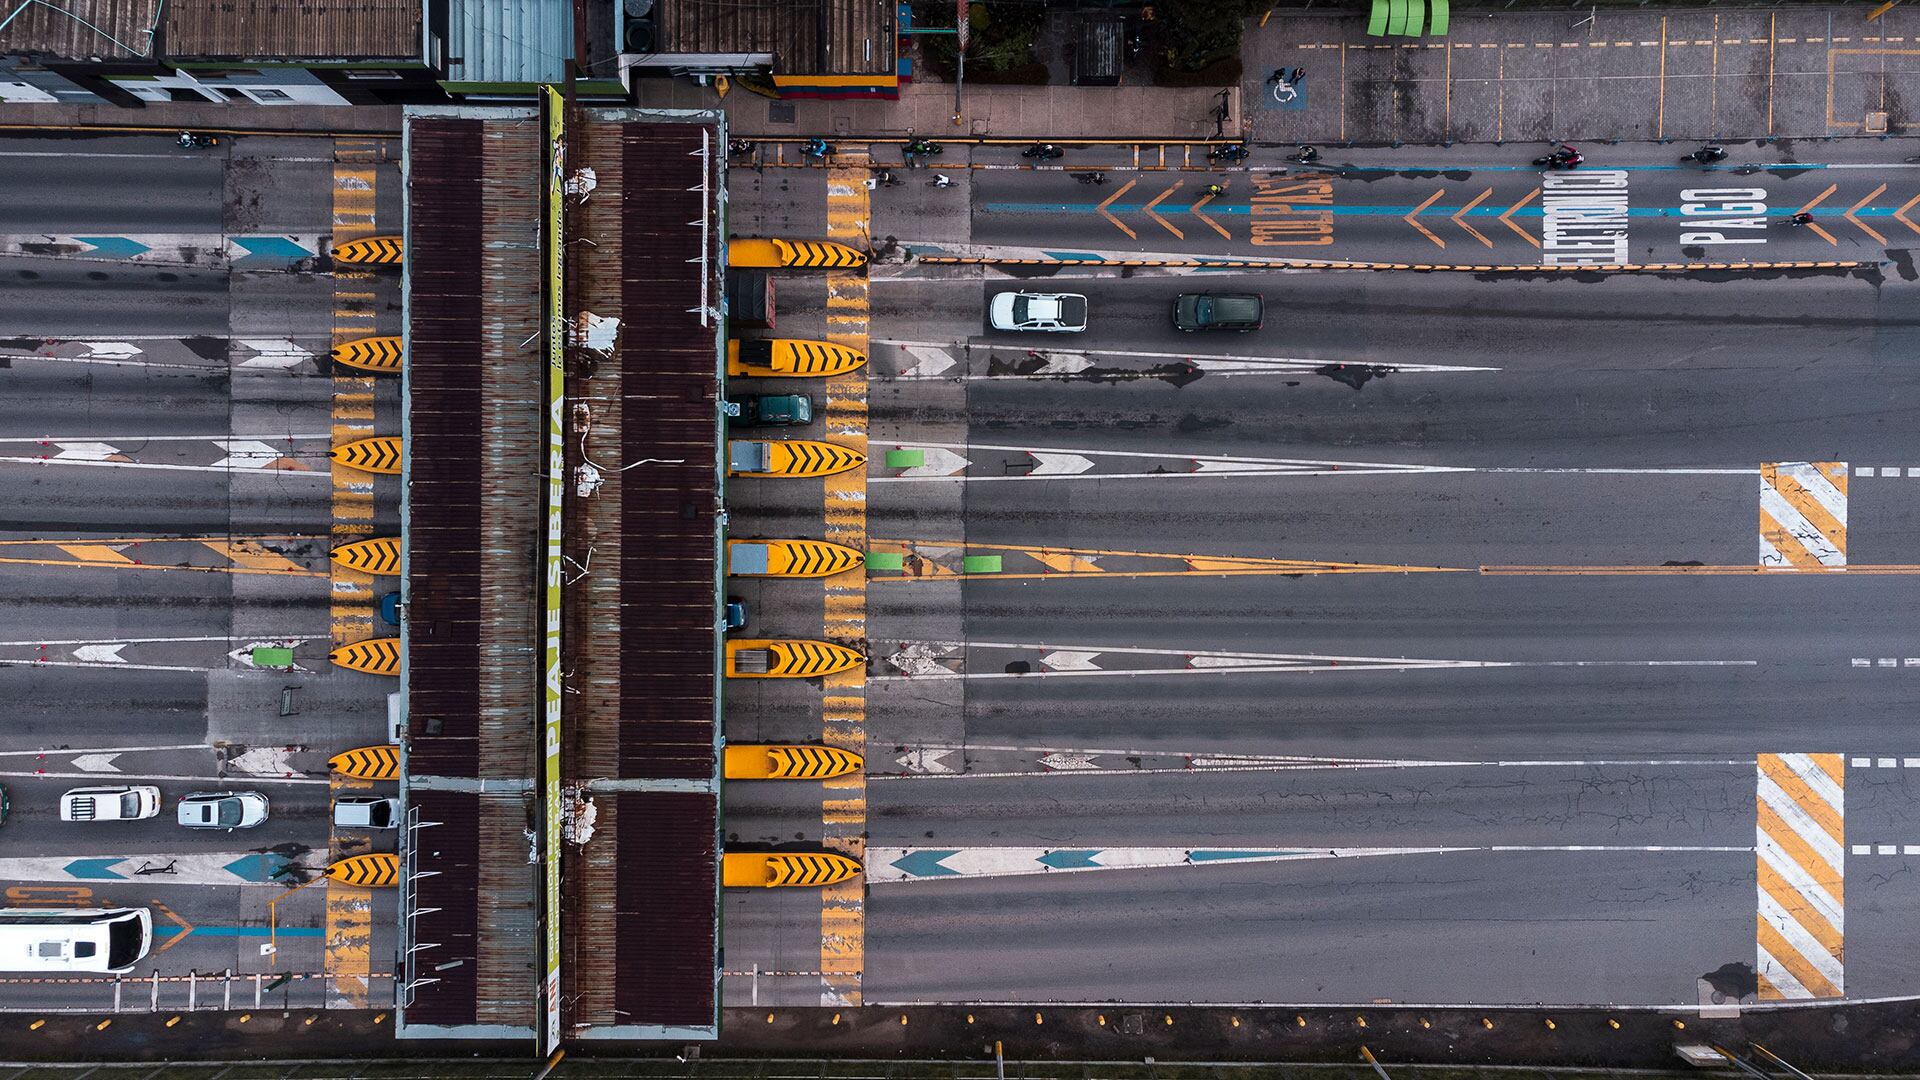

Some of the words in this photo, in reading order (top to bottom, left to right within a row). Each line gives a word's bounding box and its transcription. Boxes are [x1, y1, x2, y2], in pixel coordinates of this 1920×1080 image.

[1543, 170, 1628, 266] ELECTRONICO
[1680, 188, 1767, 244] PAGO
[556, 356, 562, 369] lo
[549, 394, 563, 588] SIBERIA
[546, 608, 561, 758] PEAJE
[549, 977, 557, 1012] ANI
